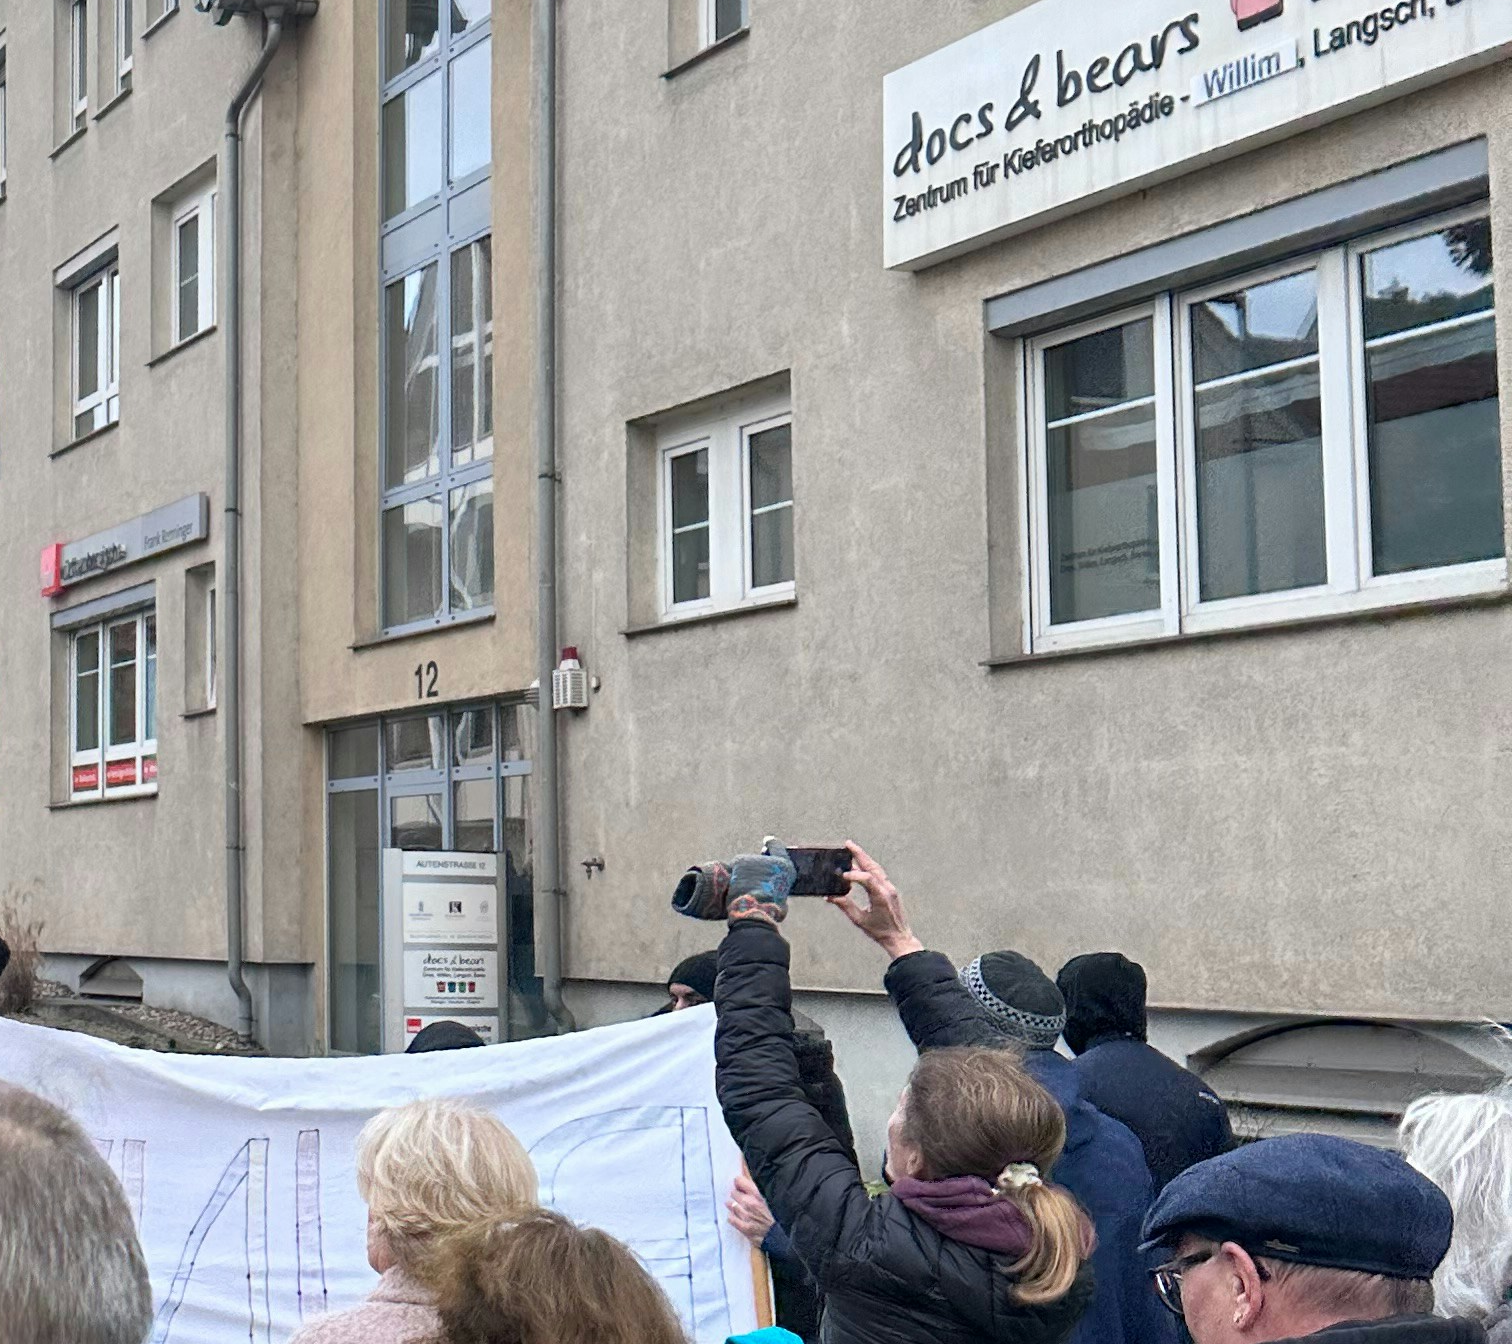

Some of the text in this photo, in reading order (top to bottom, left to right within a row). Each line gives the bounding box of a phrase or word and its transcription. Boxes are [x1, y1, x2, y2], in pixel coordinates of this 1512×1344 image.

[892, 12, 1200, 177] docs & bears
[892, 175, 969, 222] Zentrum
[973, 160, 1000, 191] für
[1003, 92, 1175, 179] Kieferorthopädie
[414, 660, 439, 699] 12
